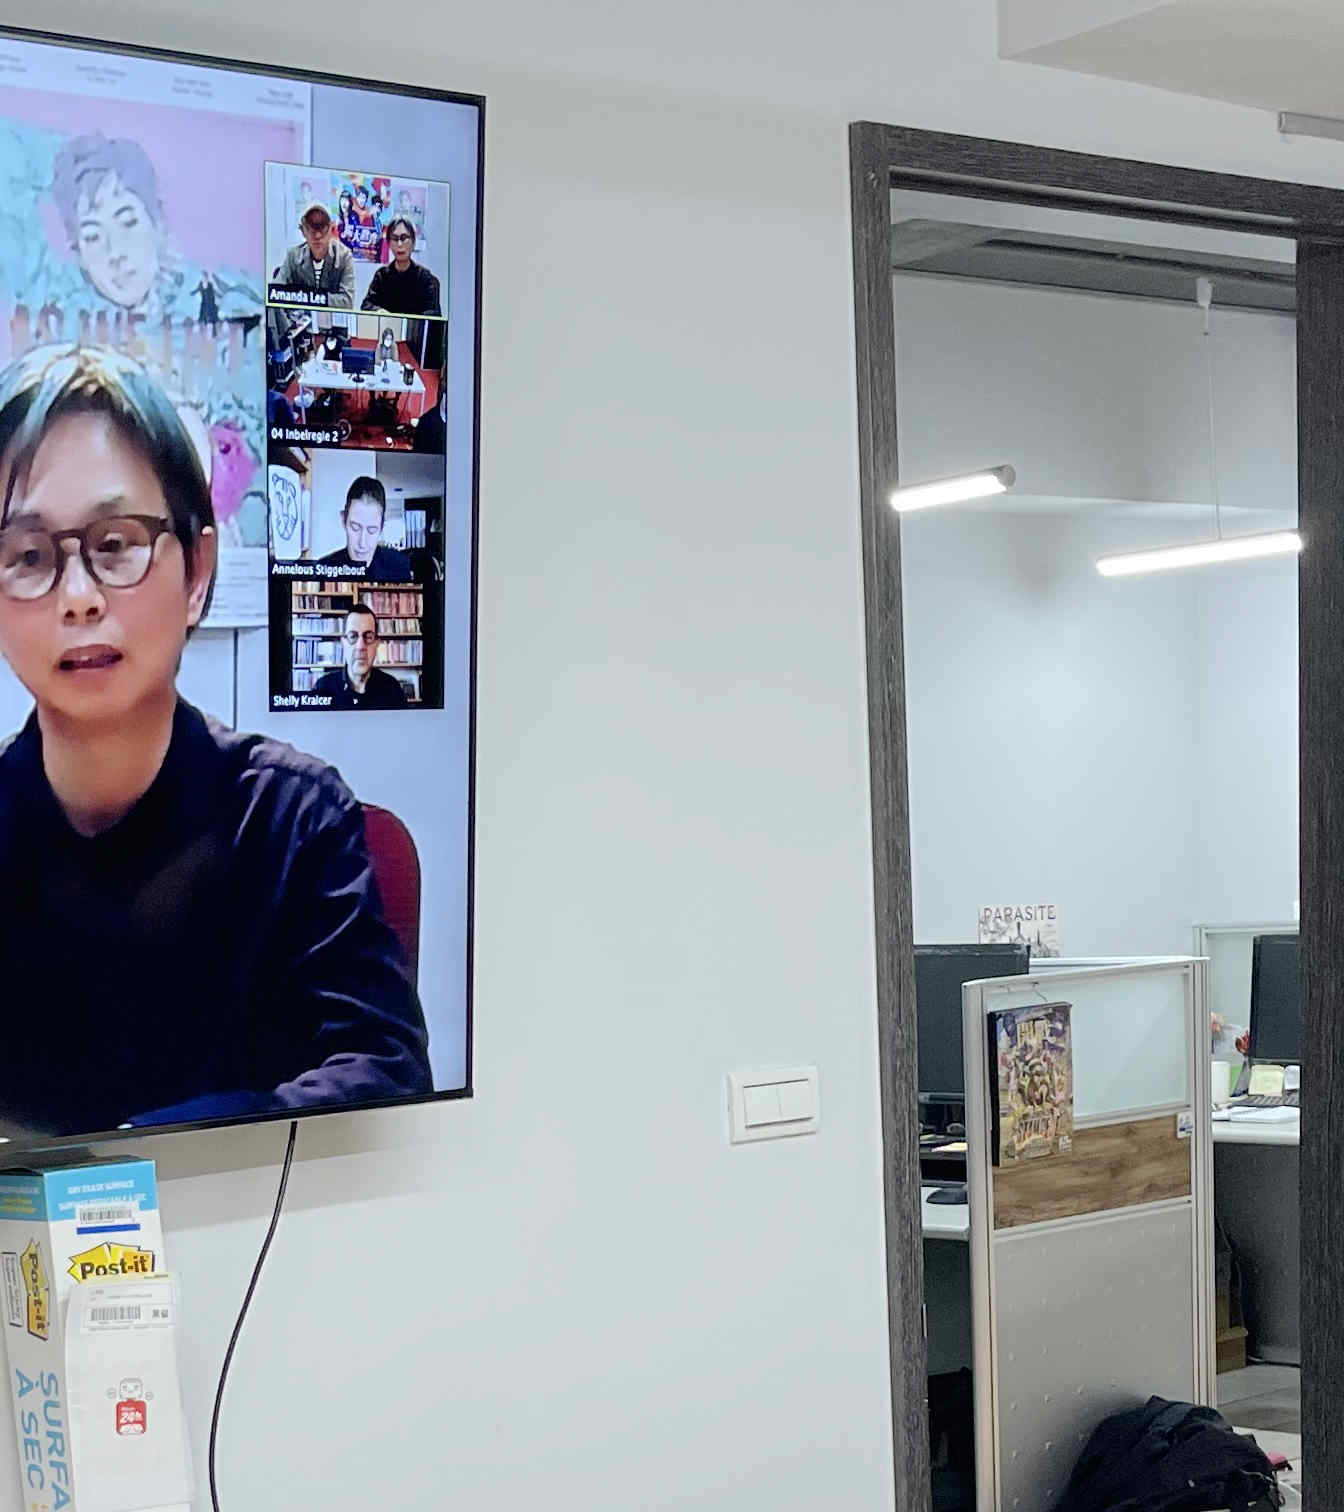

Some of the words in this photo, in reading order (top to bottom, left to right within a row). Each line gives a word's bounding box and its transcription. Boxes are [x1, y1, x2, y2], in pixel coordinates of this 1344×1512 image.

[269, 288, 309, 303] Amanda
[310, 291, 327, 305] Lee
[271, 427, 284, 440] 04
[332, 430, 339, 442] 2
[273, 694, 300, 708] Shelly
[983, 904, 1057, 921] PARASITE
[80, 1254, 148, 1281] Post-it
[20, 1408, 46, 1491] SEC
